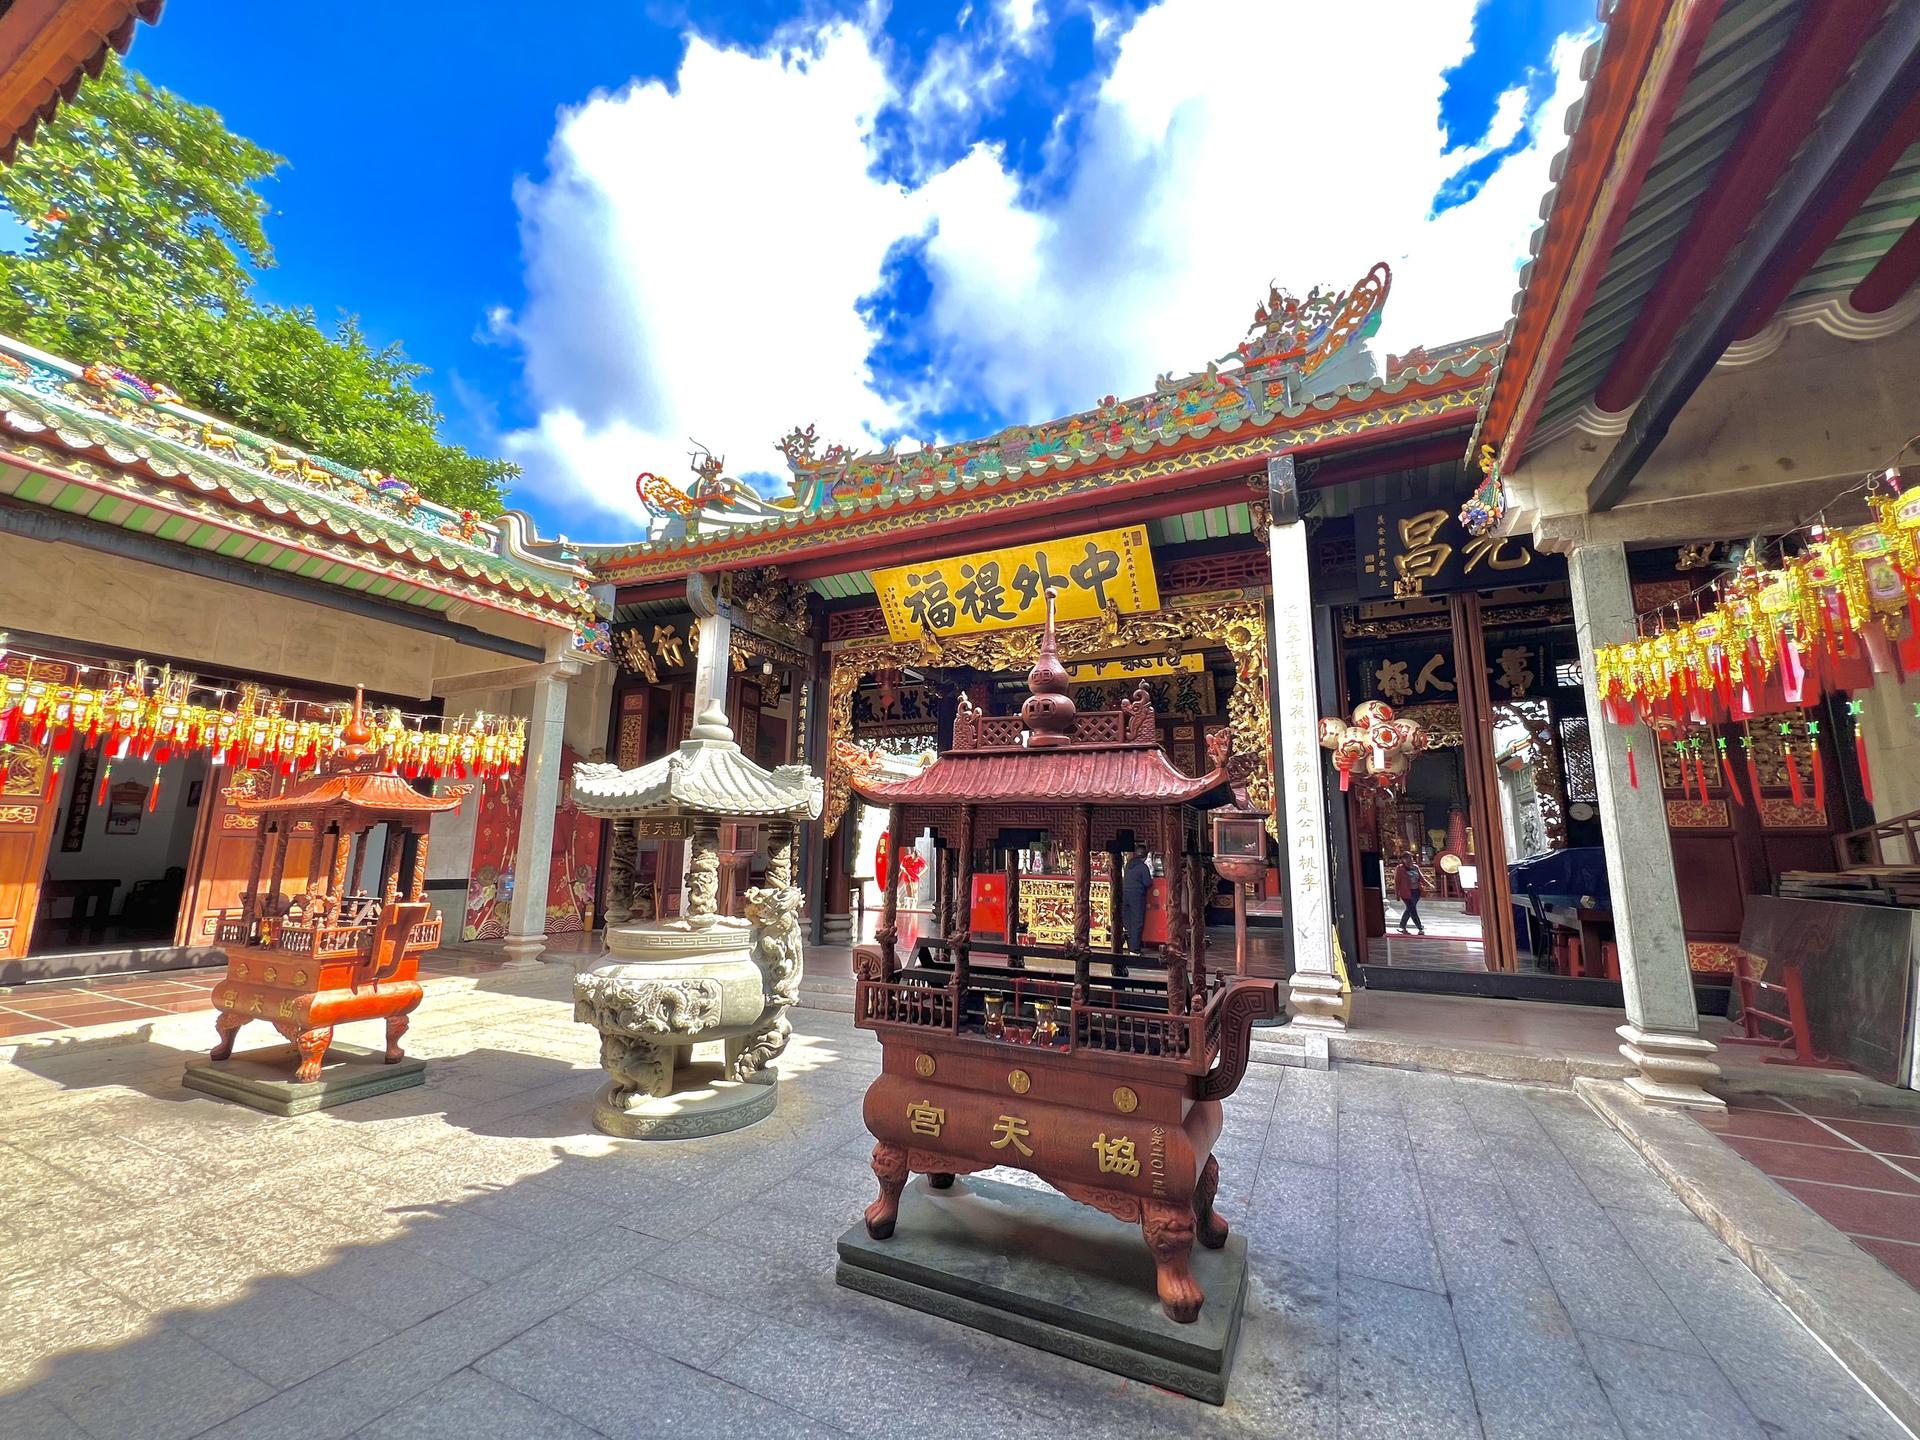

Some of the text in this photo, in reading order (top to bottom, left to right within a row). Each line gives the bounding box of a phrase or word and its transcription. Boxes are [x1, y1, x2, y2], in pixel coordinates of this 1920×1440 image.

[903, 541, 1120, 629] 中外禔福
[1375, 646, 1535, 698] 萬人極
[906, 1100, 1141, 1177] 協天宮
